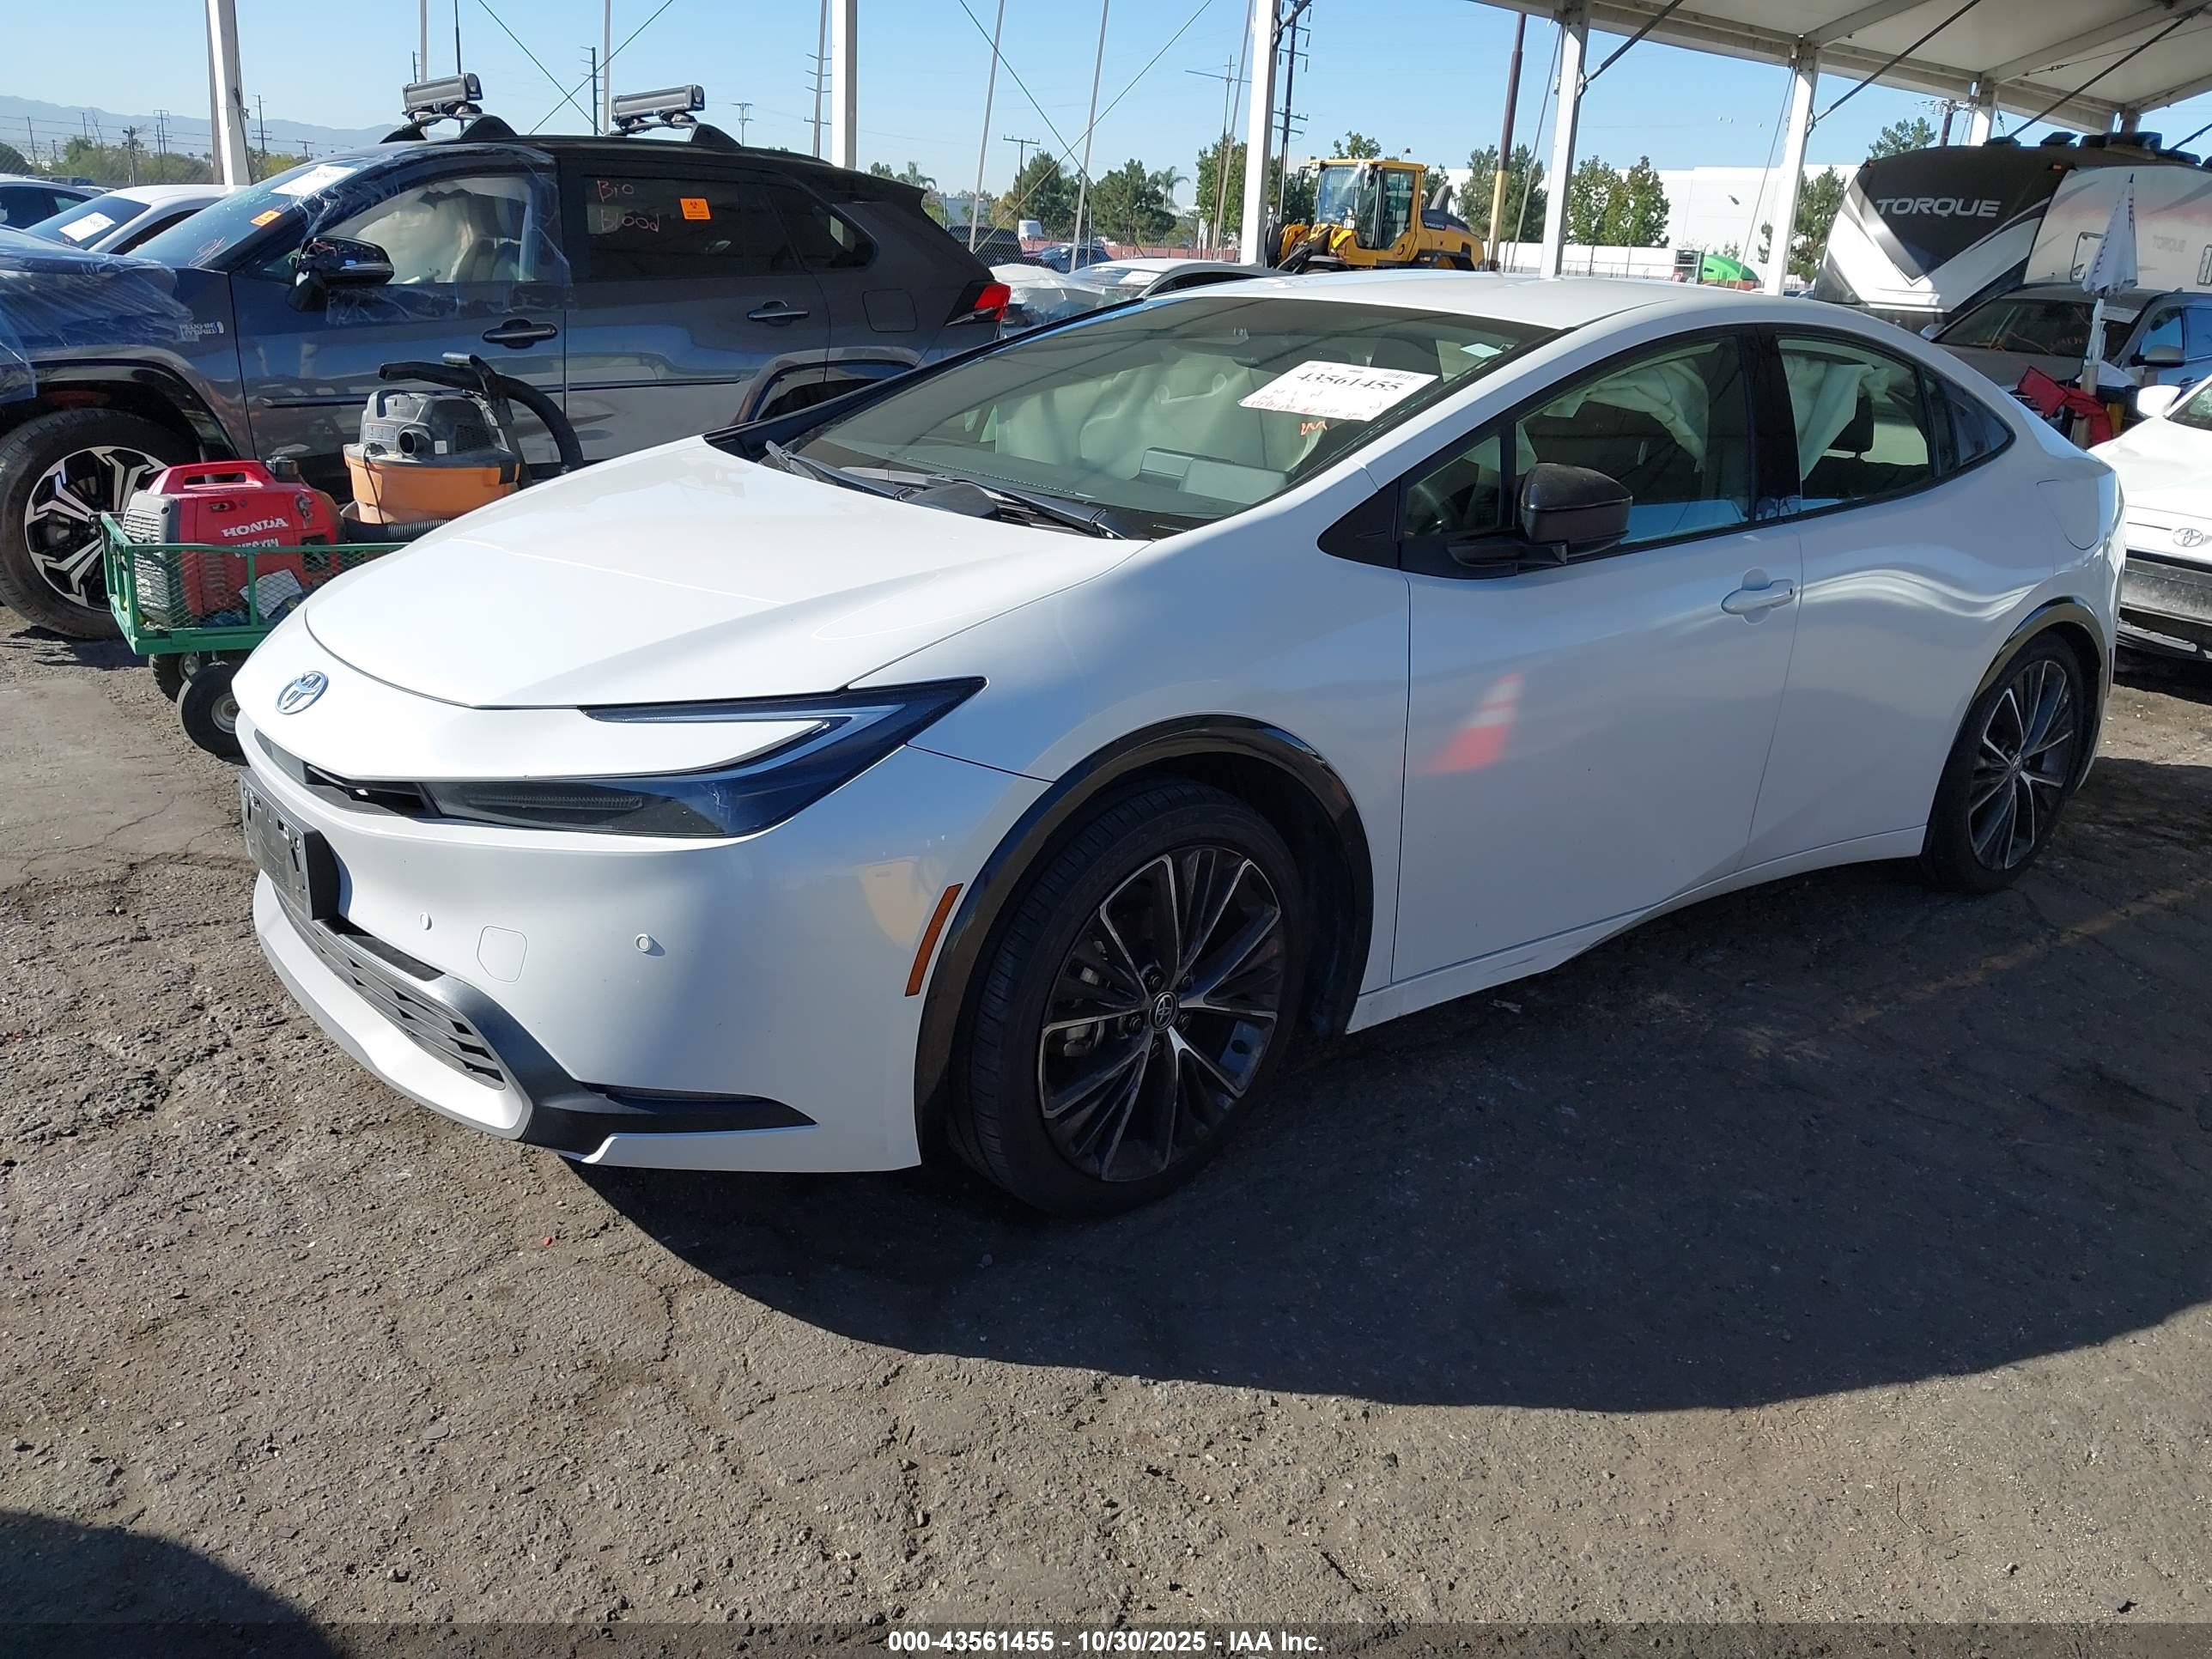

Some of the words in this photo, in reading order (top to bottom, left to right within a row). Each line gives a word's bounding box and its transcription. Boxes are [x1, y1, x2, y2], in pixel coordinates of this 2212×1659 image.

[598, 179, 634, 202] Bio
[1875, 198, 2002, 217] TORQUE
[1297, 373, 1405, 391] 43561455
[221, 517, 289, 537] HONDA
